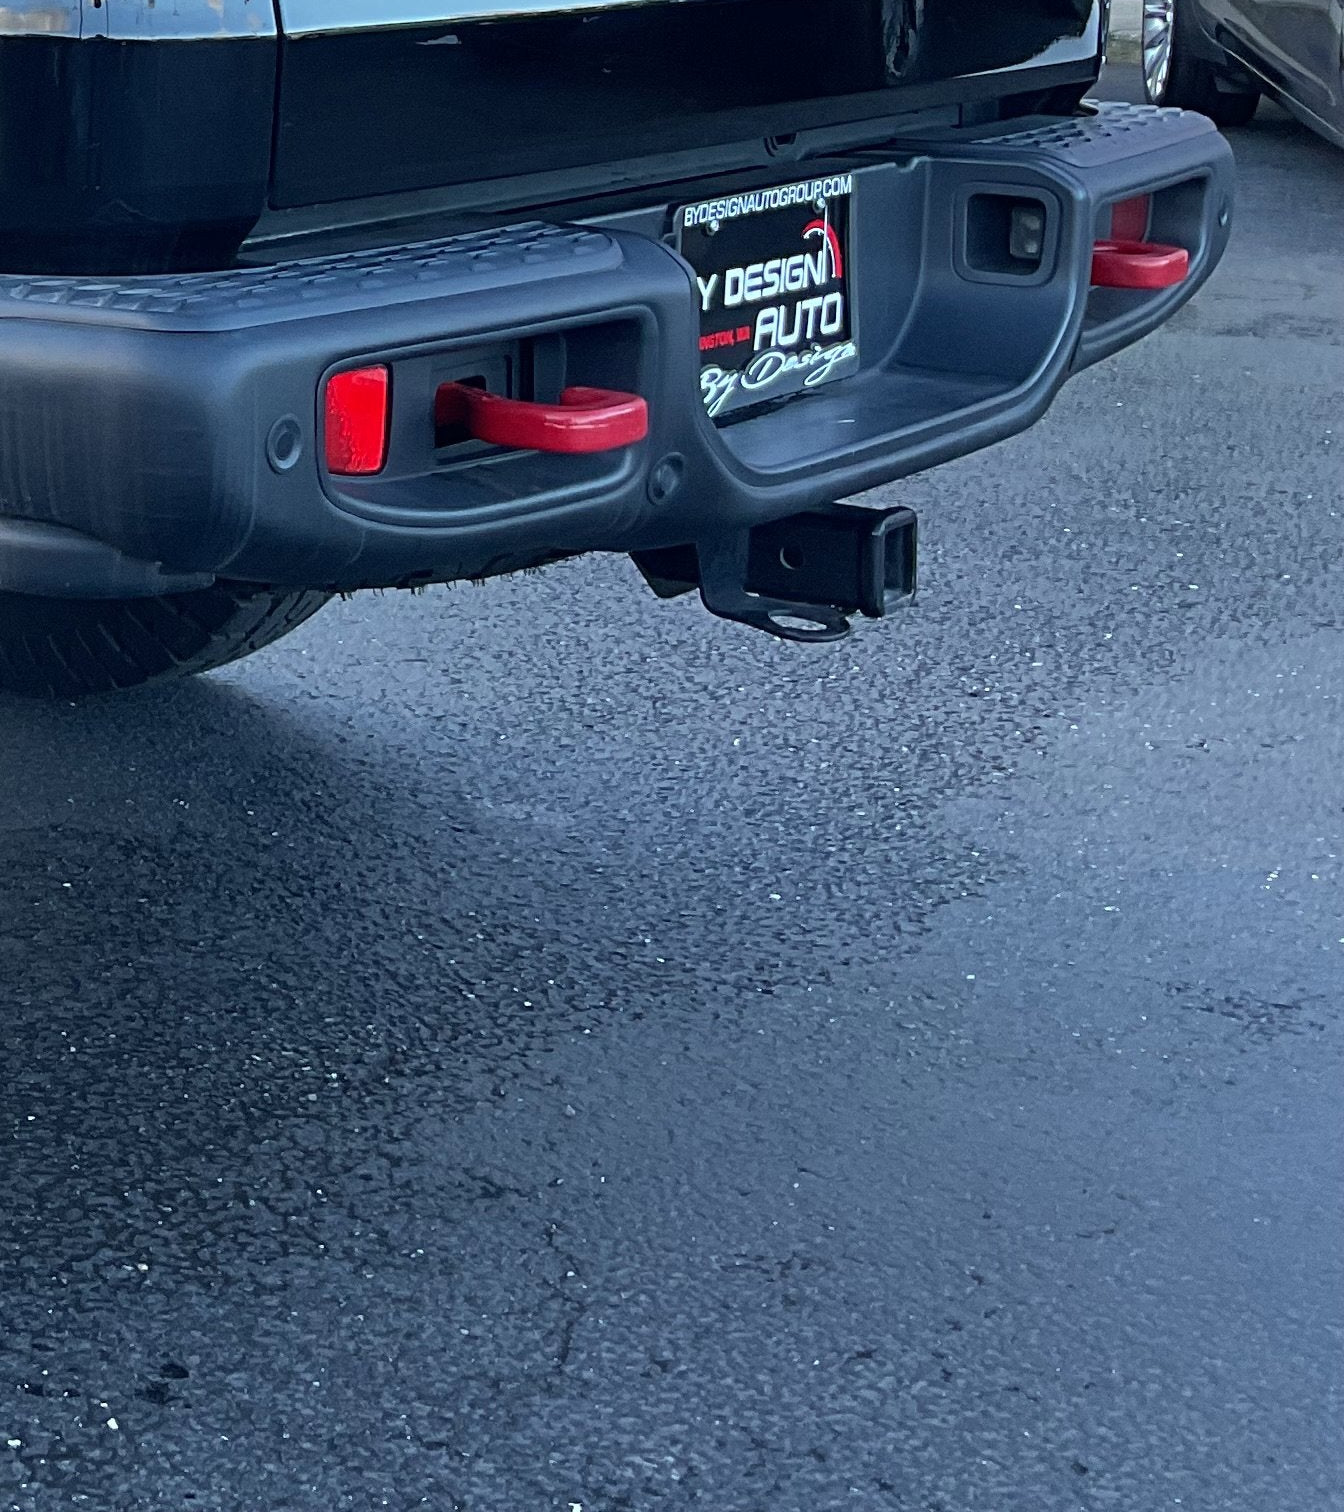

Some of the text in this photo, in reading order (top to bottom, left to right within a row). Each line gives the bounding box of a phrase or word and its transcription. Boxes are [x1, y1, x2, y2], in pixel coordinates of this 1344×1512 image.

[697, 250, 827, 311] Y DESIGN
[753, 291, 843, 351] AUTO
[699, 340, 856, 417] By Design
